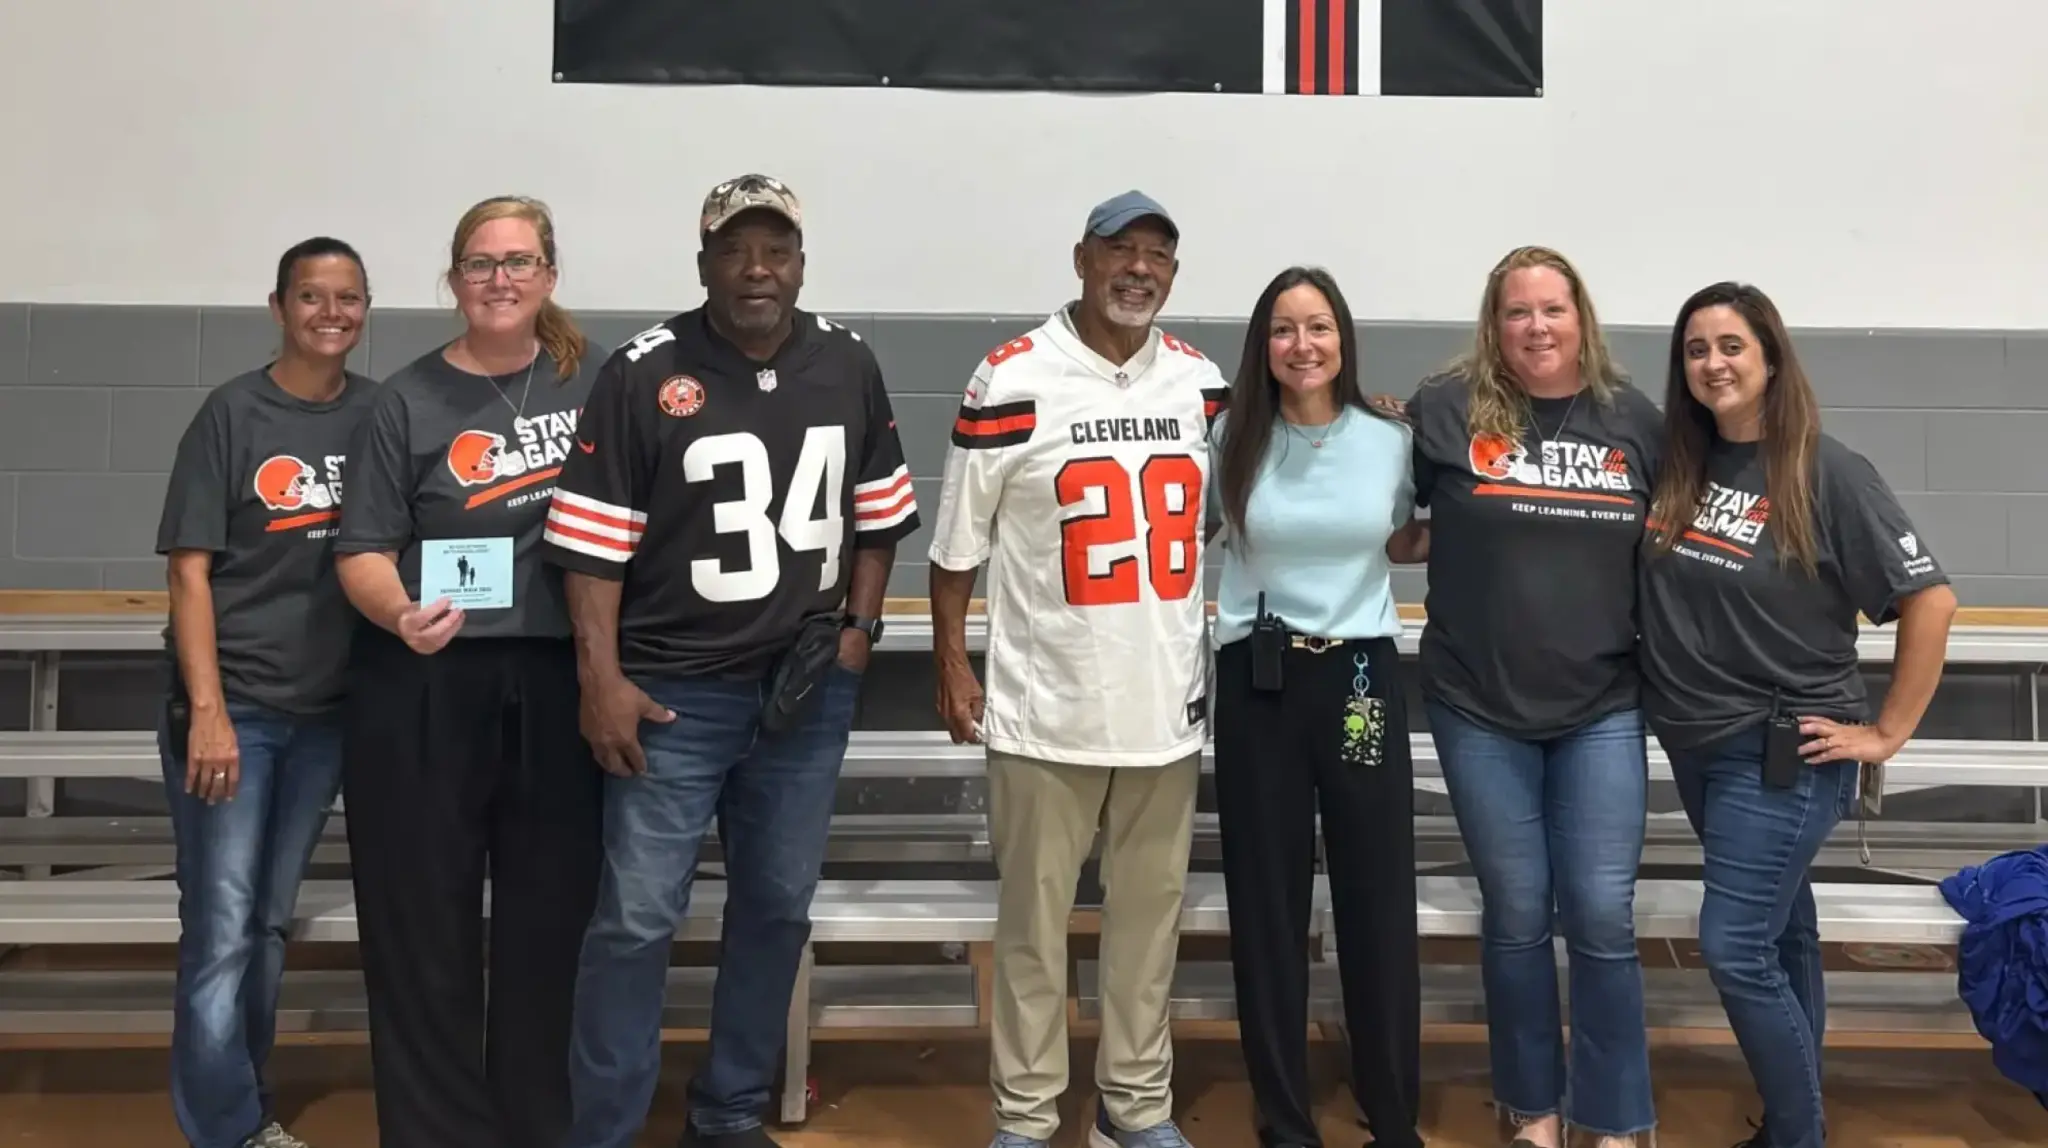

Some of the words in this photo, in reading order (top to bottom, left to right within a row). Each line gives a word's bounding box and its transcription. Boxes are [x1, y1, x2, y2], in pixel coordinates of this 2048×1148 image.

[1070, 418, 1181, 445] CLEVELAND
[1541, 440, 1609, 469] STAY
[1542, 464, 1632, 491] GAME!
[683, 425, 846, 603] 34
[1512, 502, 1536, 513] KEEP
[1538, 505, 1589, 519] LEARNING,
[1591, 510, 1621, 520] EVERY
[1055, 453, 1202, 606] 28
[1724, 559, 1744, 573] DAY
